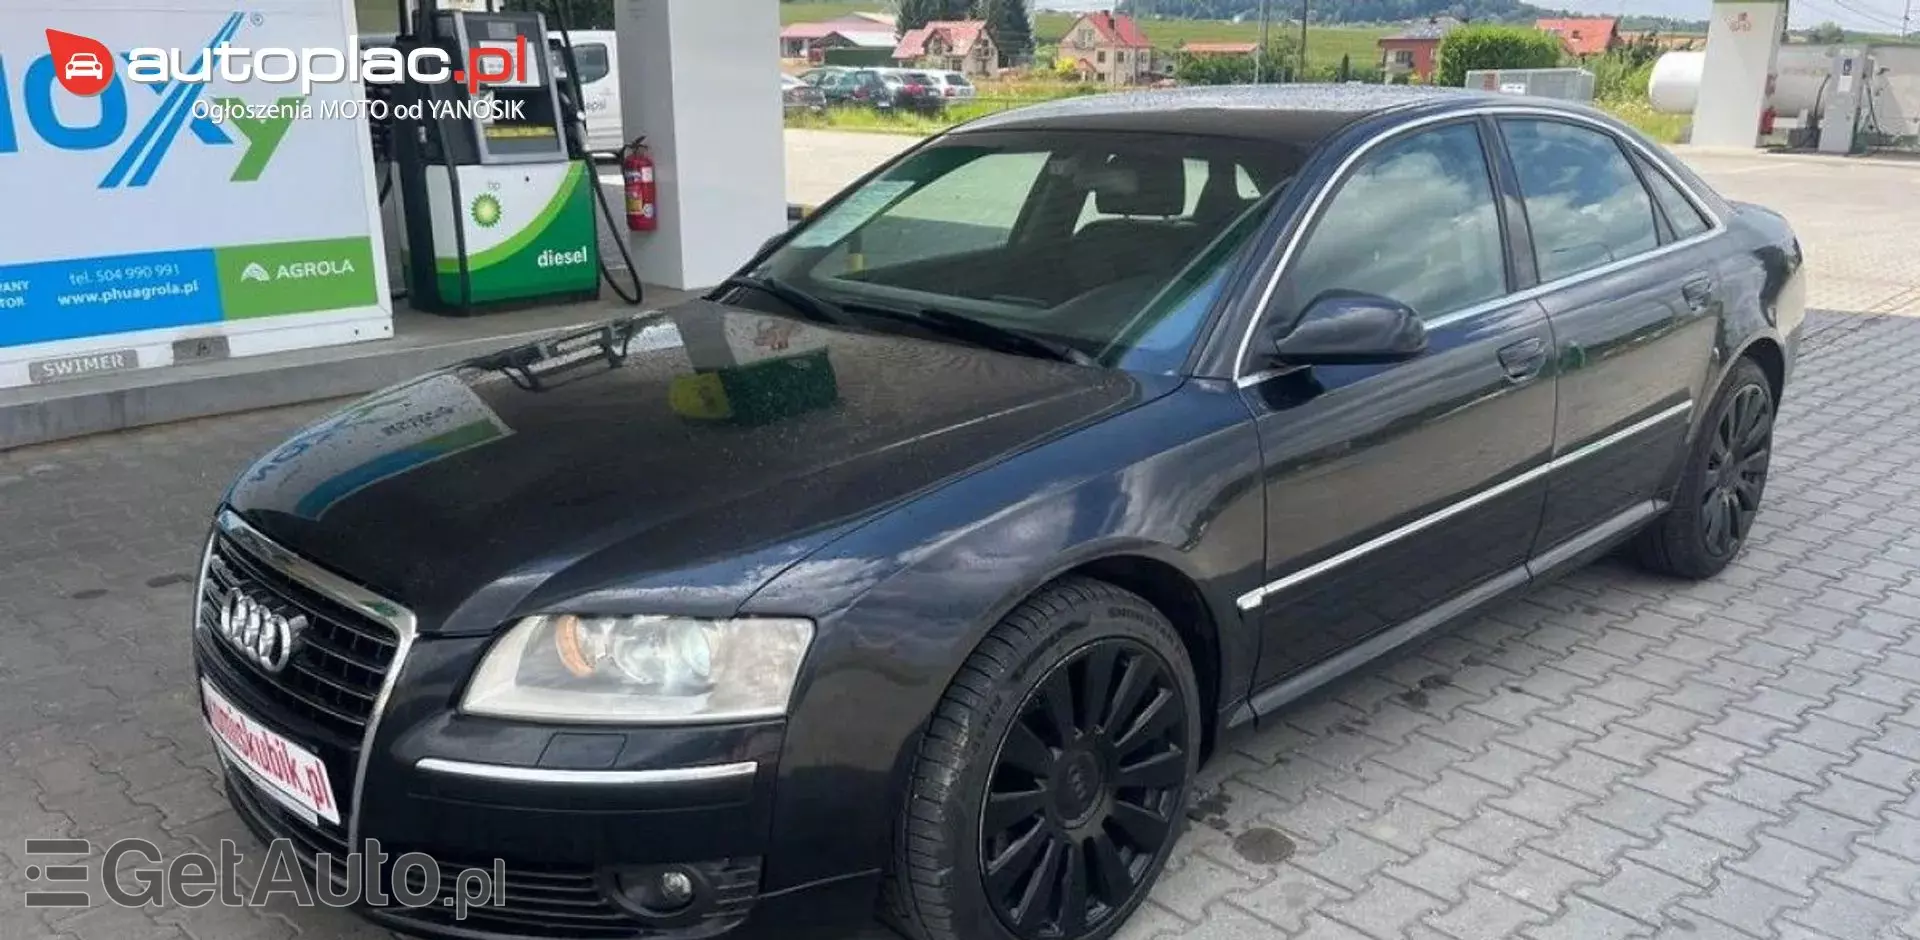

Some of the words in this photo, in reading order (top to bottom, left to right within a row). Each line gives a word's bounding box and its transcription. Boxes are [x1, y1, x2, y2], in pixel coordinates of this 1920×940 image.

[537, 246, 588, 267] diesel
[69, 272, 91, 286] tel.
[96, 269, 123, 282] 504
[125, 266, 153, 280] 990
[155, 263, 180, 277] 991
[276, 259, 355, 280] AGROLA
[57, 280, 200, 306] www.phuagrola.pl
[42, 353, 125, 378] SWIMER
